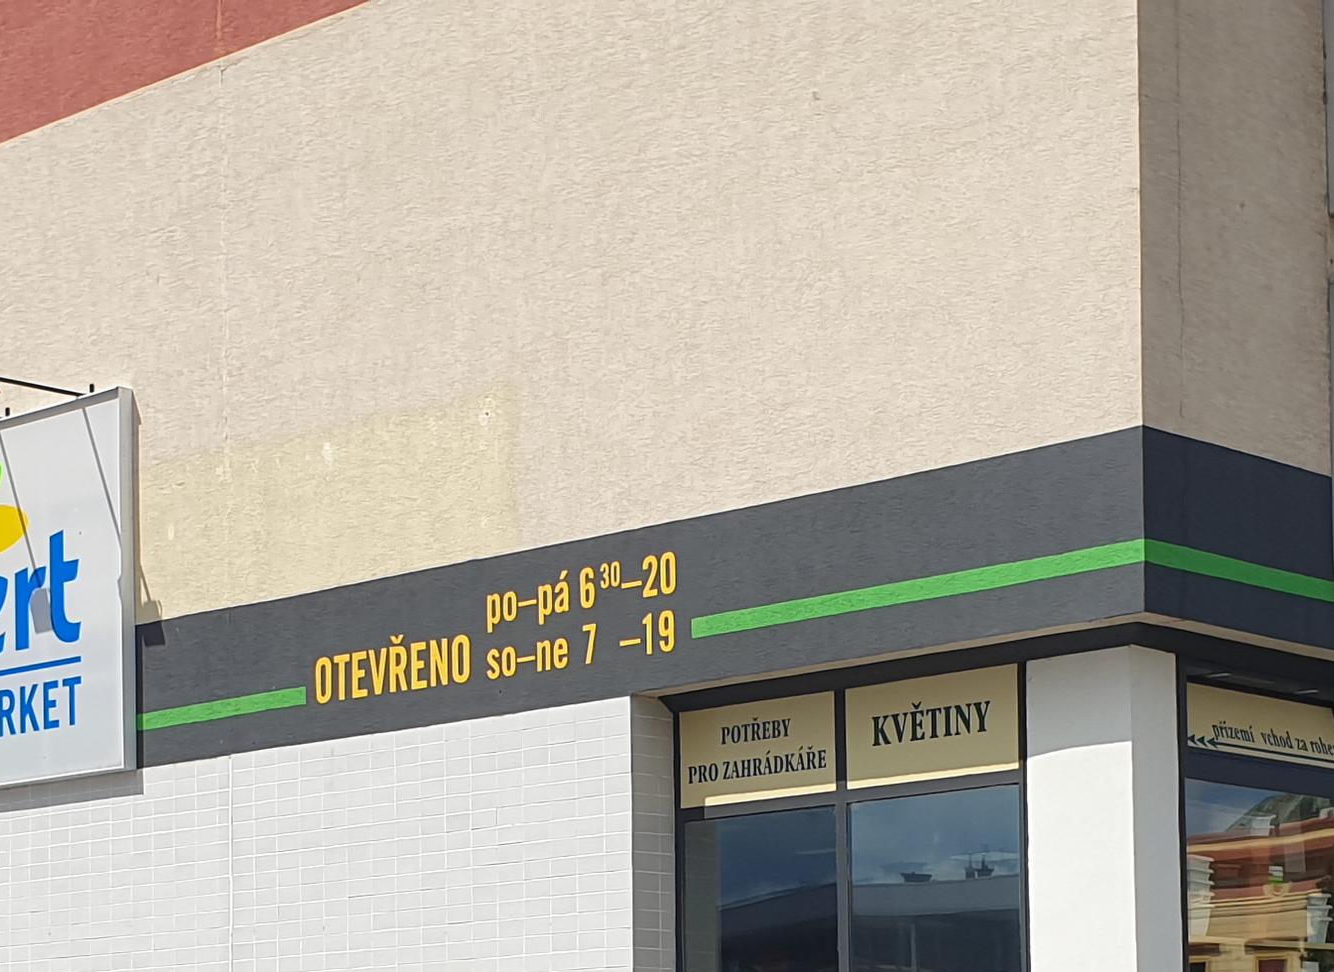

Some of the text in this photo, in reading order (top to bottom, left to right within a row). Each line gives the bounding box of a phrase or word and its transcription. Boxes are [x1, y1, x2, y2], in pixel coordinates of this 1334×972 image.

[582, 623, 597, 665] 7
[314, 634, 471, 704] OTEVŘENO
[720, 717, 791, 746] POTŘEBY
[872, 701, 991, 747] KVĚTINY
[1212, 720, 1255, 744] přízemí
[1260, 730, 1293, 750] vchod
[1295, 736, 1308, 752] za
[688, 745, 827, 785] PRO ZAHRÁDKÁŘE
